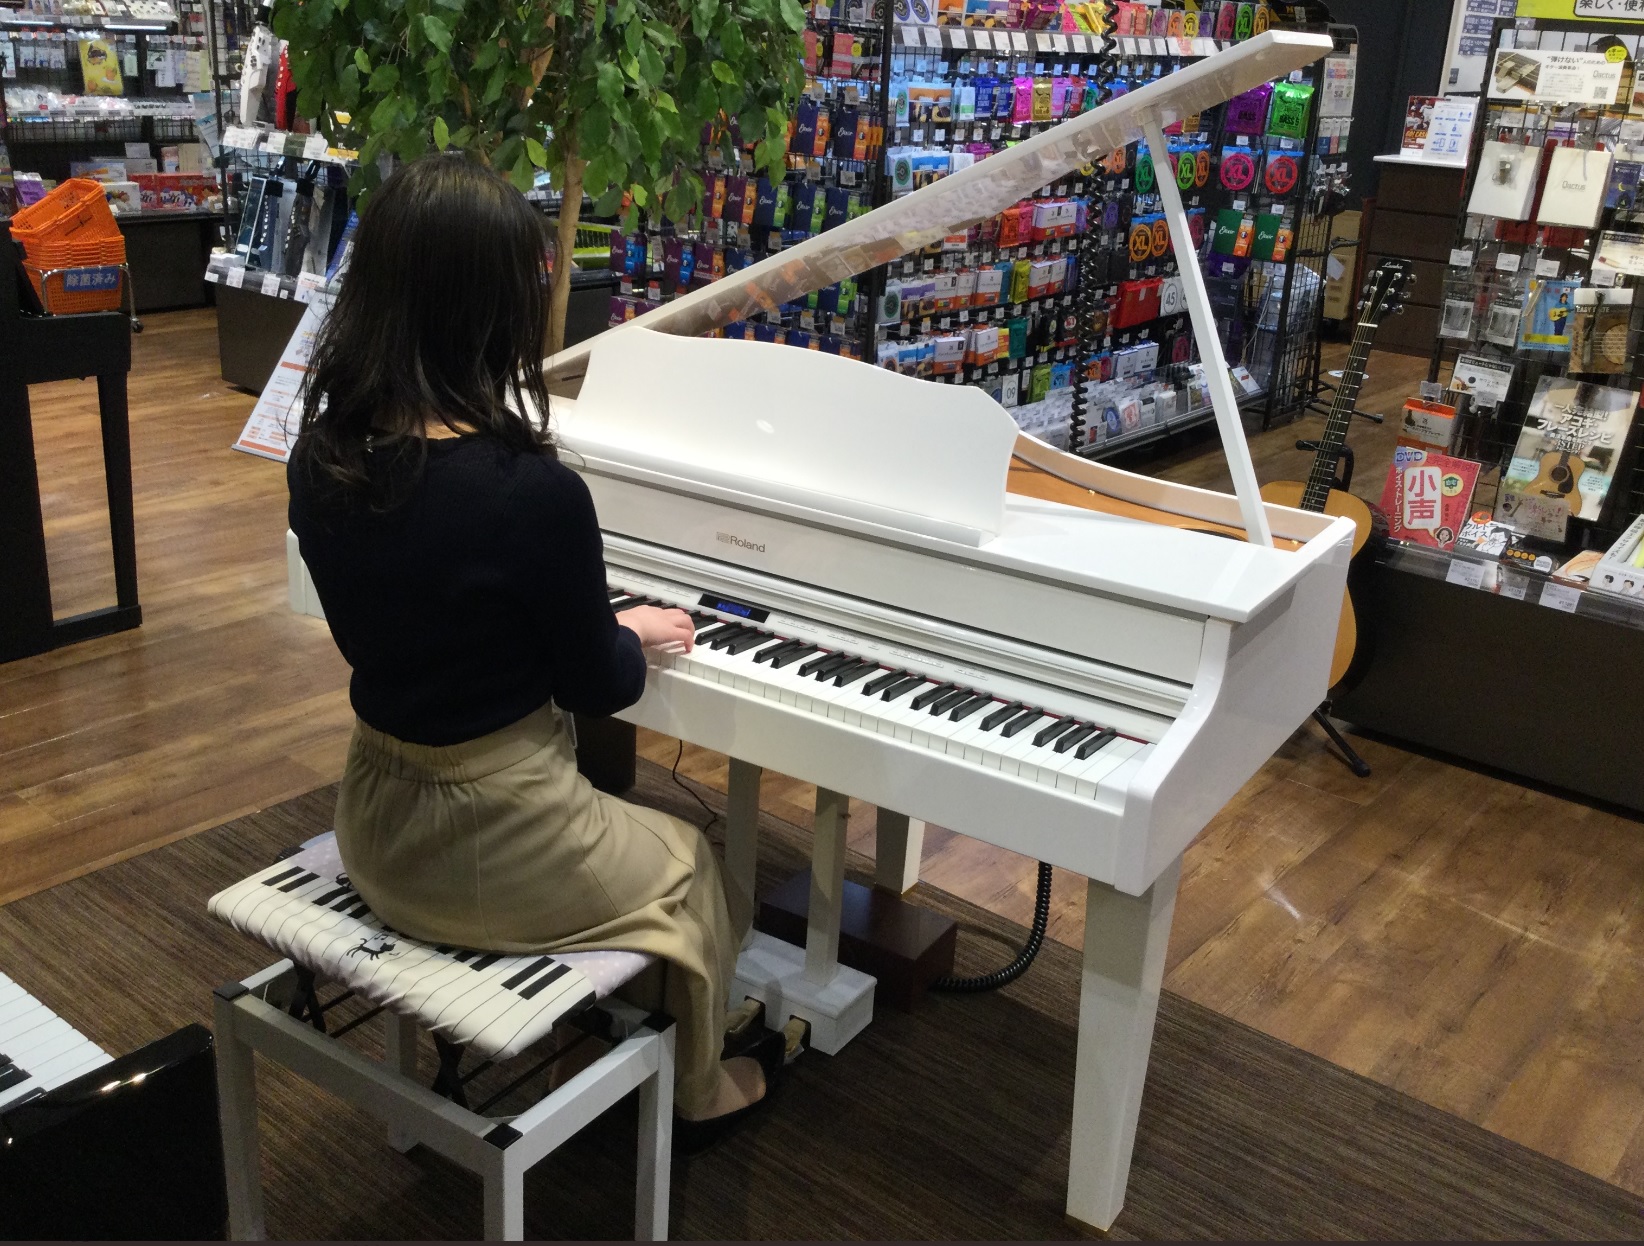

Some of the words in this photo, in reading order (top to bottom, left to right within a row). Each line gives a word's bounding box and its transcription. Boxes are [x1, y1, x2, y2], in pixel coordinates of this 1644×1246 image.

[799, 123, 813, 133] Elixir
[838, 127, 853, 137] Elixir
[1180, 164, 1193, 178] XL
[759, 196, 773, 205] Elixir
[1219, 226, 1235, 234] Elixir
[1258, 231, 1274, 240] Elixir
[1133, 235, 1148, 250] XL
[1154, 230, 1166, 245] XL
[66, 272, 116, 287] 除菌済み
[1165, 292, 1175, 305] 45
[1006, 387, 1016, 399] 09
[1396, 451, 1423, 462] DVD
[1407, 469, 1437, 525] 小声
[730, 535, 766, 552] Roland
